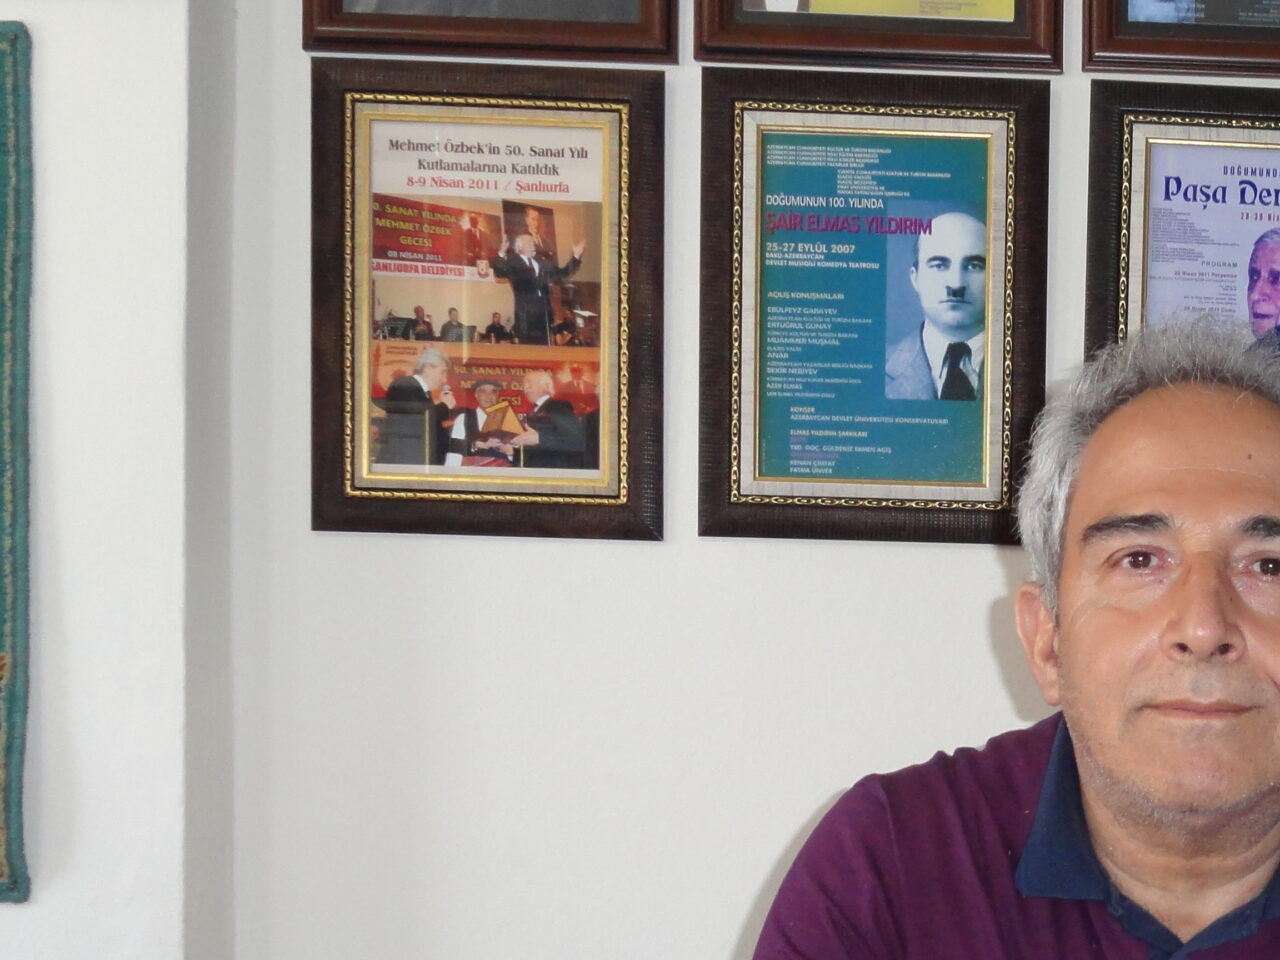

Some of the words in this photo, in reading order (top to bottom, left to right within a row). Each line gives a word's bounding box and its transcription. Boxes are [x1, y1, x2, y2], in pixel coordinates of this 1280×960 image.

[389, 139, 440, 153] Mehmet
[505, 146, 524, 157] 50.
[530, 146, 565, 158] Sanat
[569, 147, 588, 160] Yılı
[418, 159, 507, 174] Kutlamalarına
[511, 163, 560, 177] Katıldık
[406, 176, 426, 188] 8-9
[430, 176, 464, 188] Nisan
[468, 178, 498, 190] 2011
[515, 181, 570, 194] Şanlıurfa
[1163, 176, 1228, 211] Paşa
[766, 194, 826, 208] DOĞUMUNUN
[828, 197, 848, 208] 100.
[849, 198, 884, 209] YILINDA
[806, 214, 861, 234] ELMAS
[864, 216, 932, 236] YILDIRIM
[766, 242, 795, 252] 25-27
[831, 244, 856, 254] 2007
